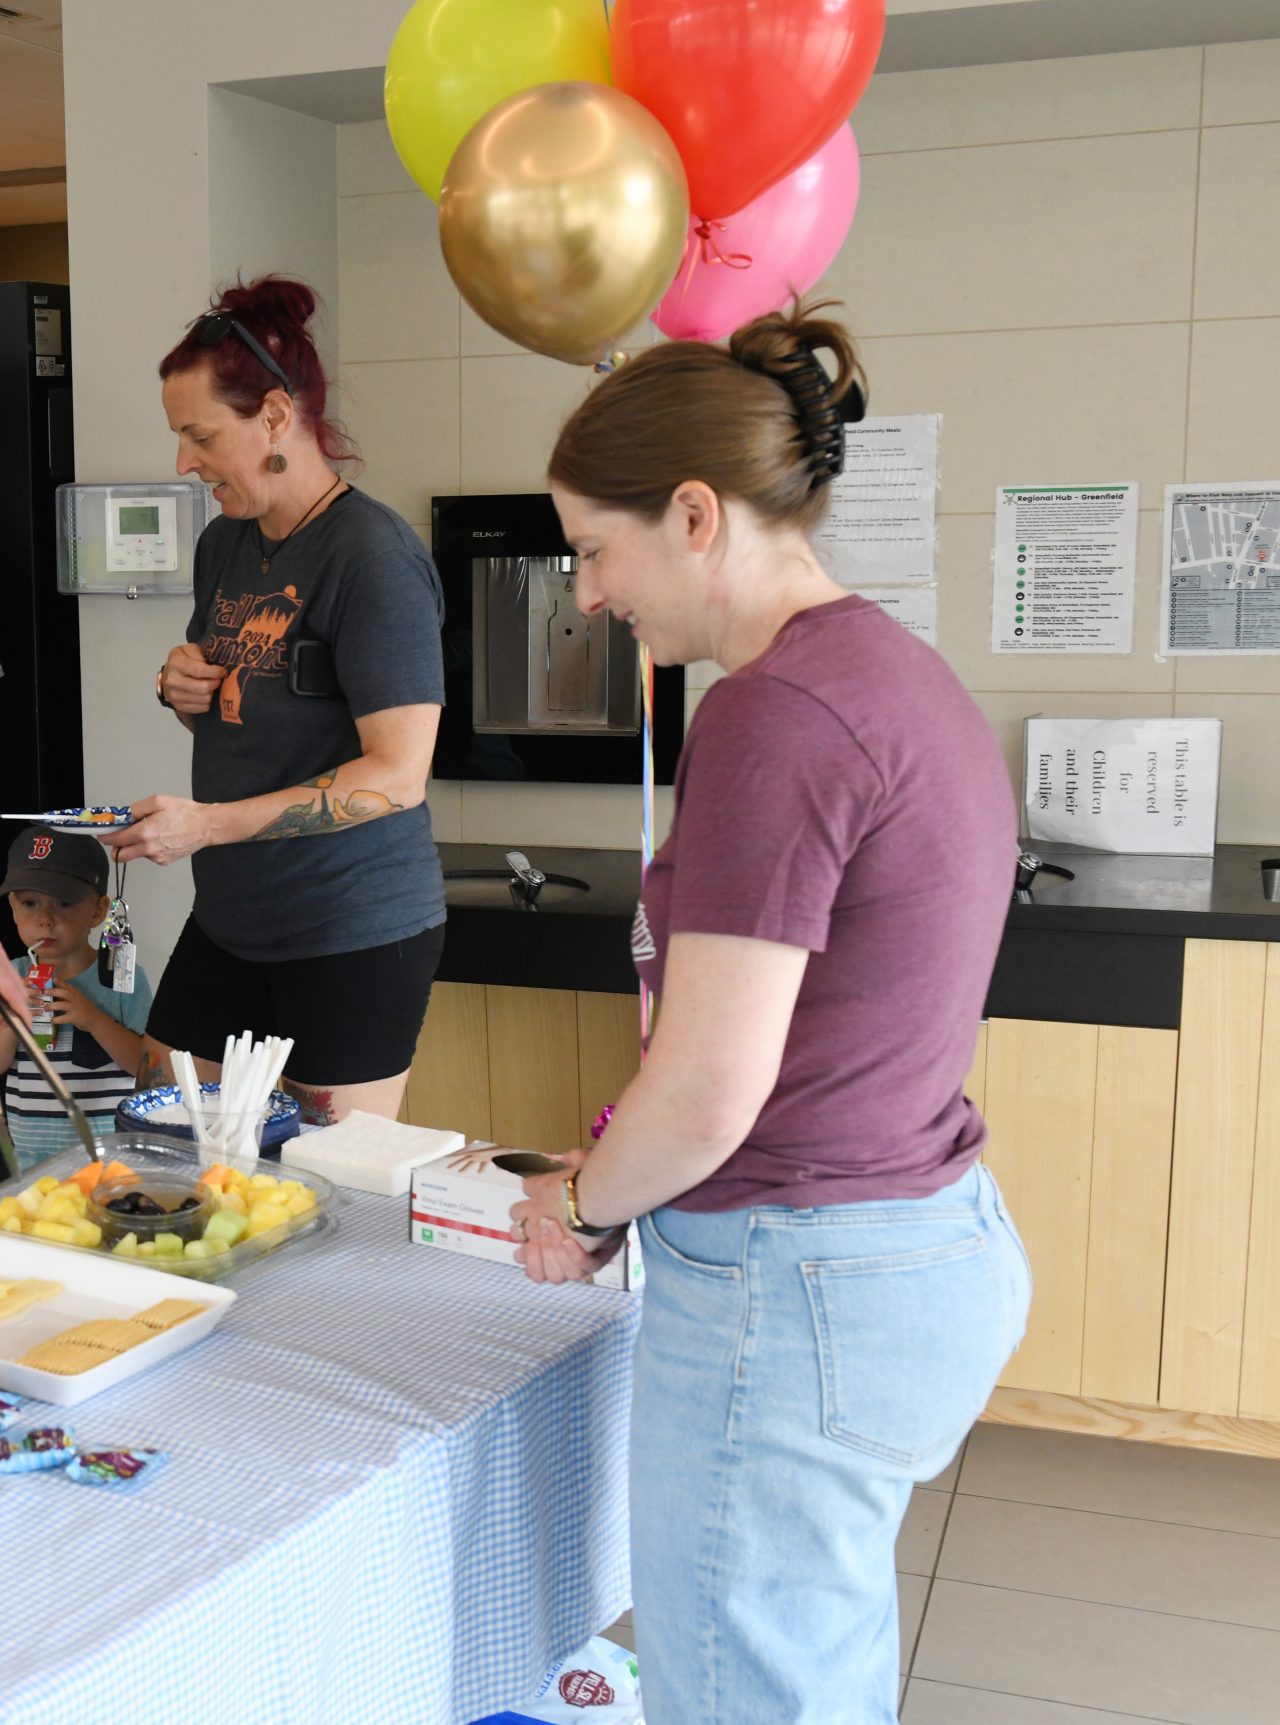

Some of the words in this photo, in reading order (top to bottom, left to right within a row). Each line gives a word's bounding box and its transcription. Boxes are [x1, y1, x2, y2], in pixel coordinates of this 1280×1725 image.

[1017, 495, 1054, 503] Regional
[201, 634, 289, 670] ermont
[243, 630, 272, 646] 2024
[1066, 748, 1079, 776] and
[1174, 738, 1189, 770] This
[1039, 753, 1053, 810] families
[1092, 750, 1106, 815] Children
[1119, 771, 1134, 794] for
[1146, 750, 1160, 815] reserved
[1173, 774, 1188, 812] table
[1065, 780, 1079, 816] their
[1173, 815, 1187, 827] is
[27, 834, 55, 860] B
